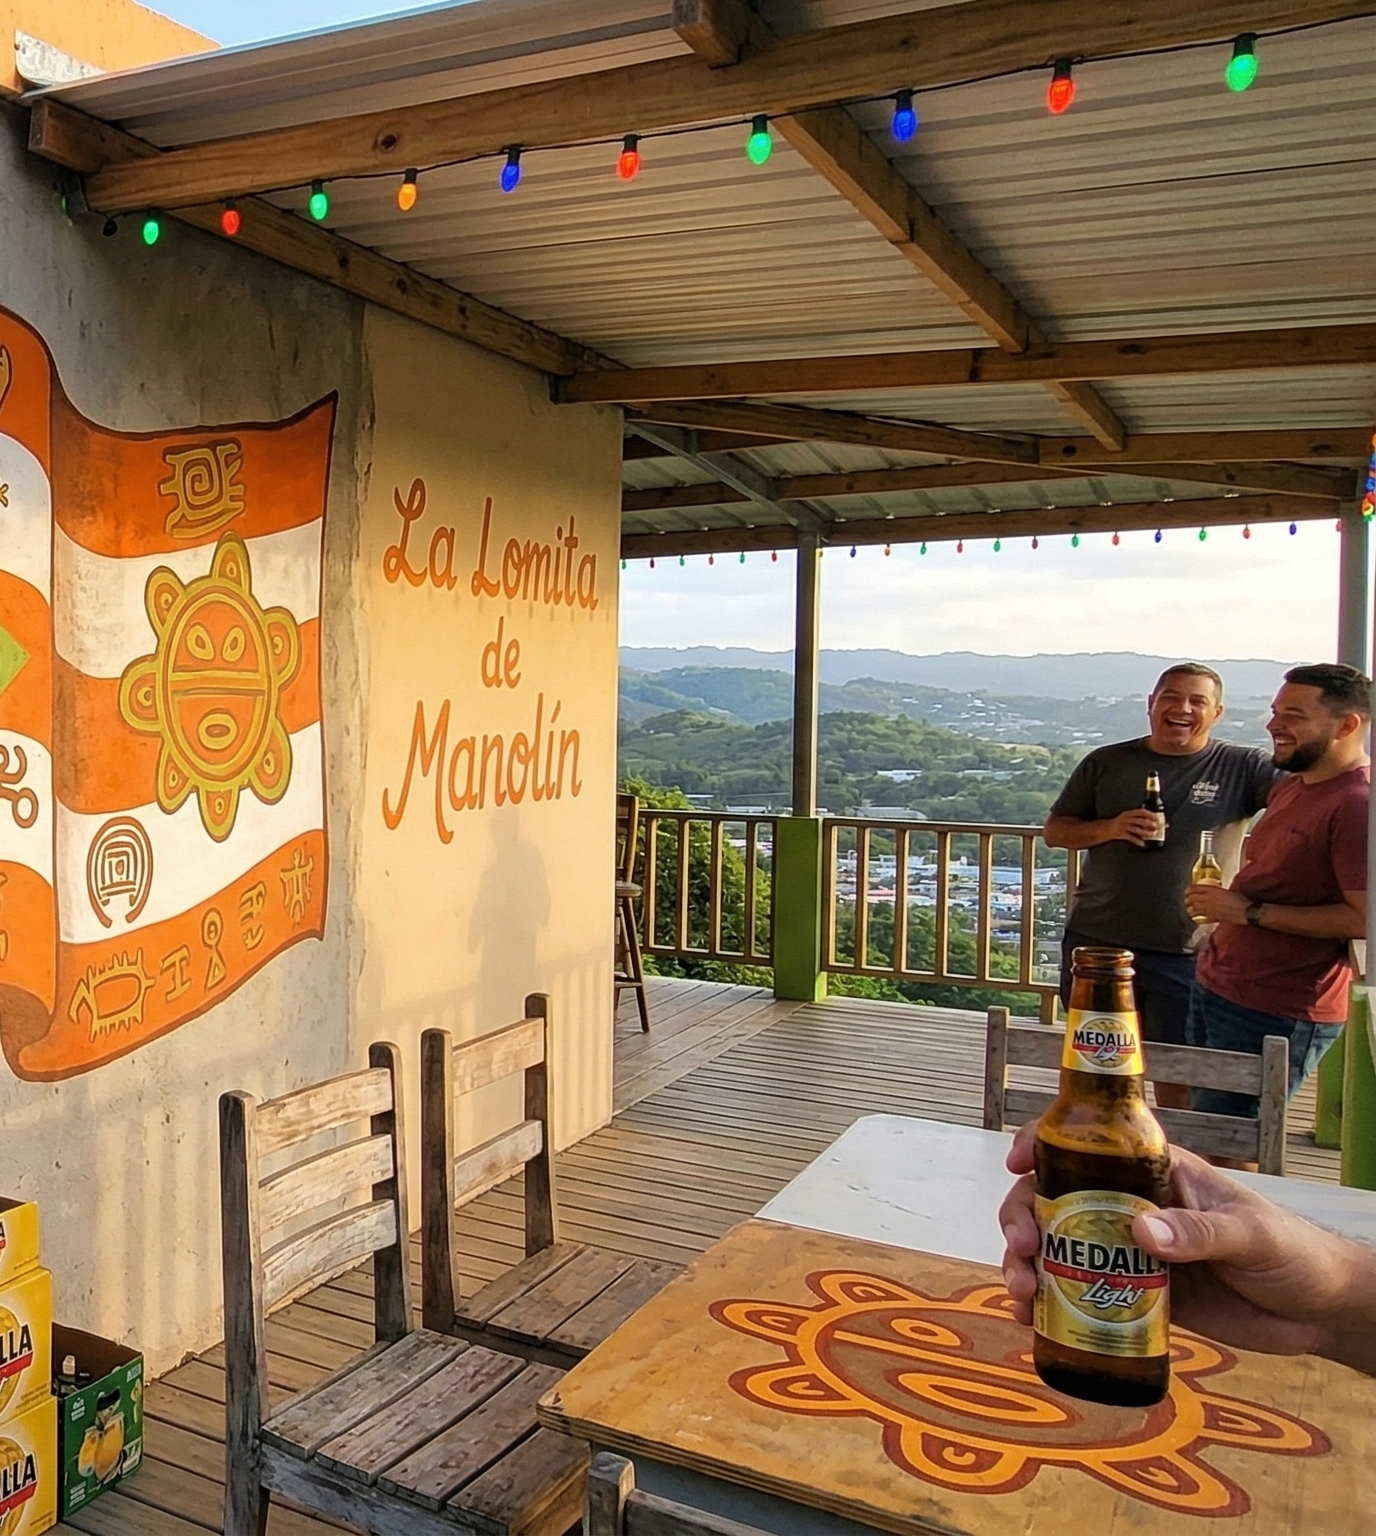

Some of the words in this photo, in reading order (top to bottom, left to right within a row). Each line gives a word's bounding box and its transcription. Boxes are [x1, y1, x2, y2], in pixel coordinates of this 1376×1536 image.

[382, 477, 458, 591] La
[470, 496, 599, 611] Lomita
[481, 616, 522, 689] de
[382, 692, 583, 845] Manolín
[1073, 1030, 1136, 1047] MEDALLA
[1080, 1278, 1146, 1309] Light
